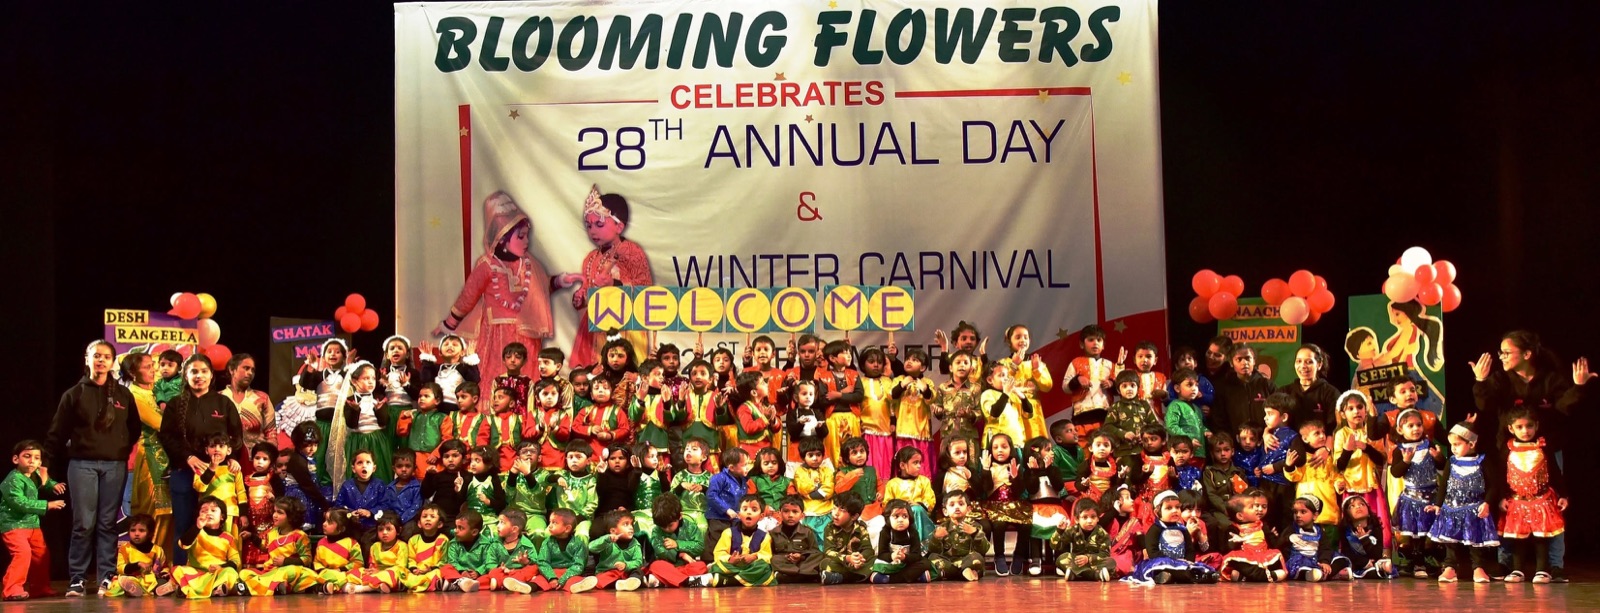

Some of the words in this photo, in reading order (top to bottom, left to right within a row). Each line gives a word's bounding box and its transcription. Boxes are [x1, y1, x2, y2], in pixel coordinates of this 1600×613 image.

[434, 10, 788, 73] BLOOMING
[813, 5, 1121, 68] FLOWERS
[670, 80, 885, 110] CELEBRATES
[704, 121, 939, 168] ANNUAL
[962, 119, 1065, 165] DAY
[798, 192, 823, 221] &
[672, 253, 840, 290] WINTER
[858, 248, 1070, 290] CARNIVAL
[106, 311, 145, 324] DESH
[594, 290, 904, 330] WELCOME
[117, 329, 197, 343] RANGEELA
[272, 324, 332, 340] CHATAK
[1223, 329, 1295, 340] PUNJABAN
[1360, 365, 1404, 383] SEETI
